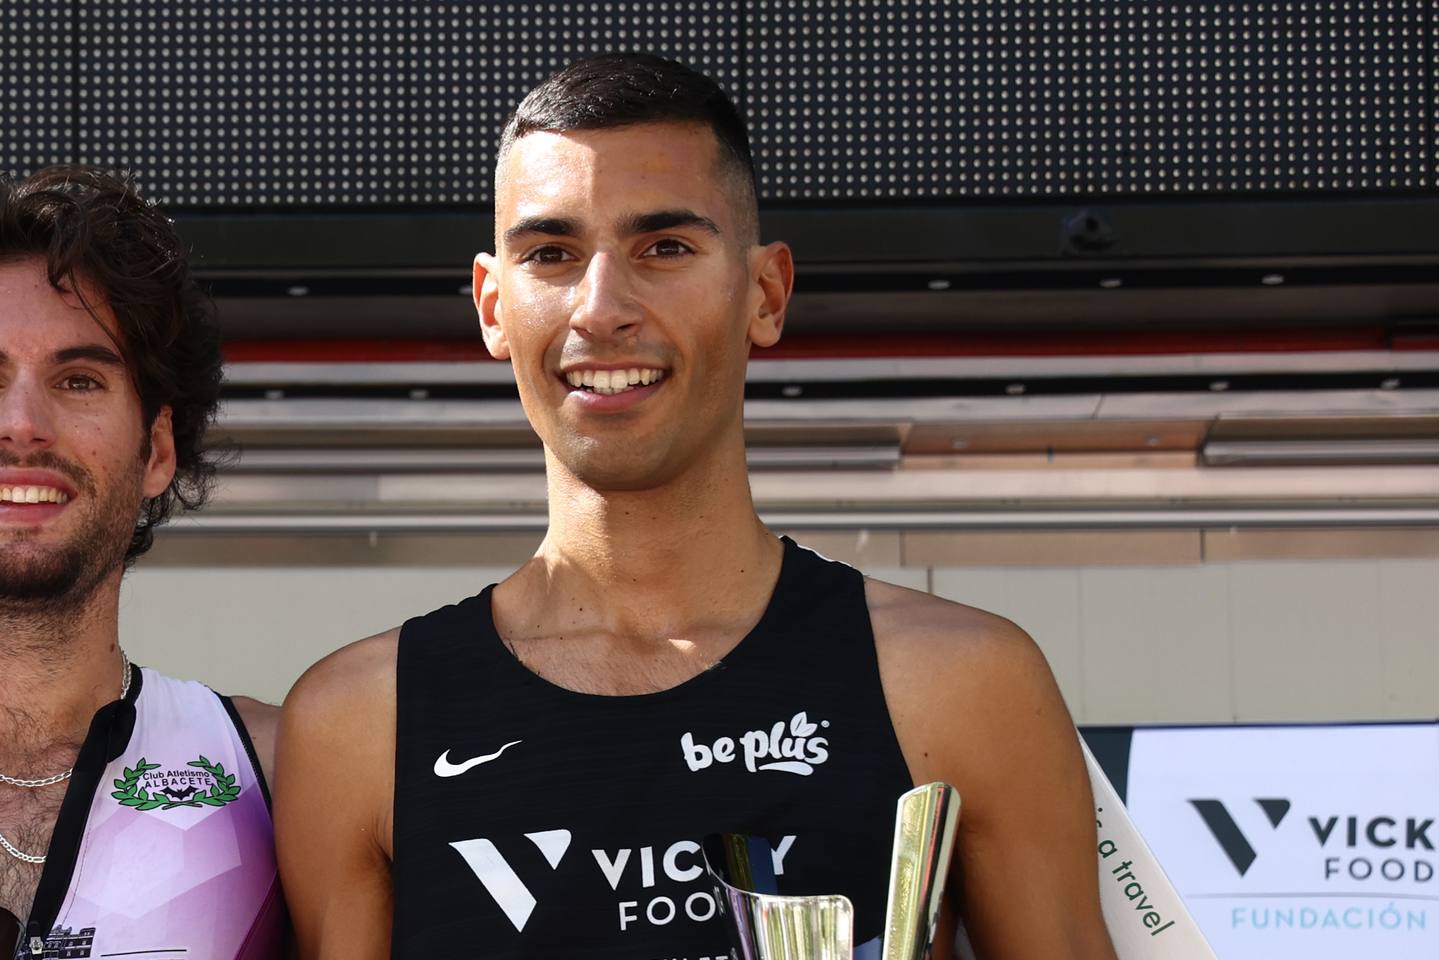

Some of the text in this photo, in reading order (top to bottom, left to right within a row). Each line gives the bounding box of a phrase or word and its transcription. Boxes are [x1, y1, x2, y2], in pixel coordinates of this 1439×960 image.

[681, 716, 829, 774] be plus
[143, 769, 210, 781] Club Atletismo
[145, 777, 213, 789] ALBACETE
[1307, 815, 1437, 850] VICK
[591, 835, 797, 891] VICY
[1324, 857, 1435, 883] FOOD
[1097, 839, 1176, 937] a travel
[618, 891, 717, 932] FOO
[1231, 902, 1427, 930] FUNDACIÓN
